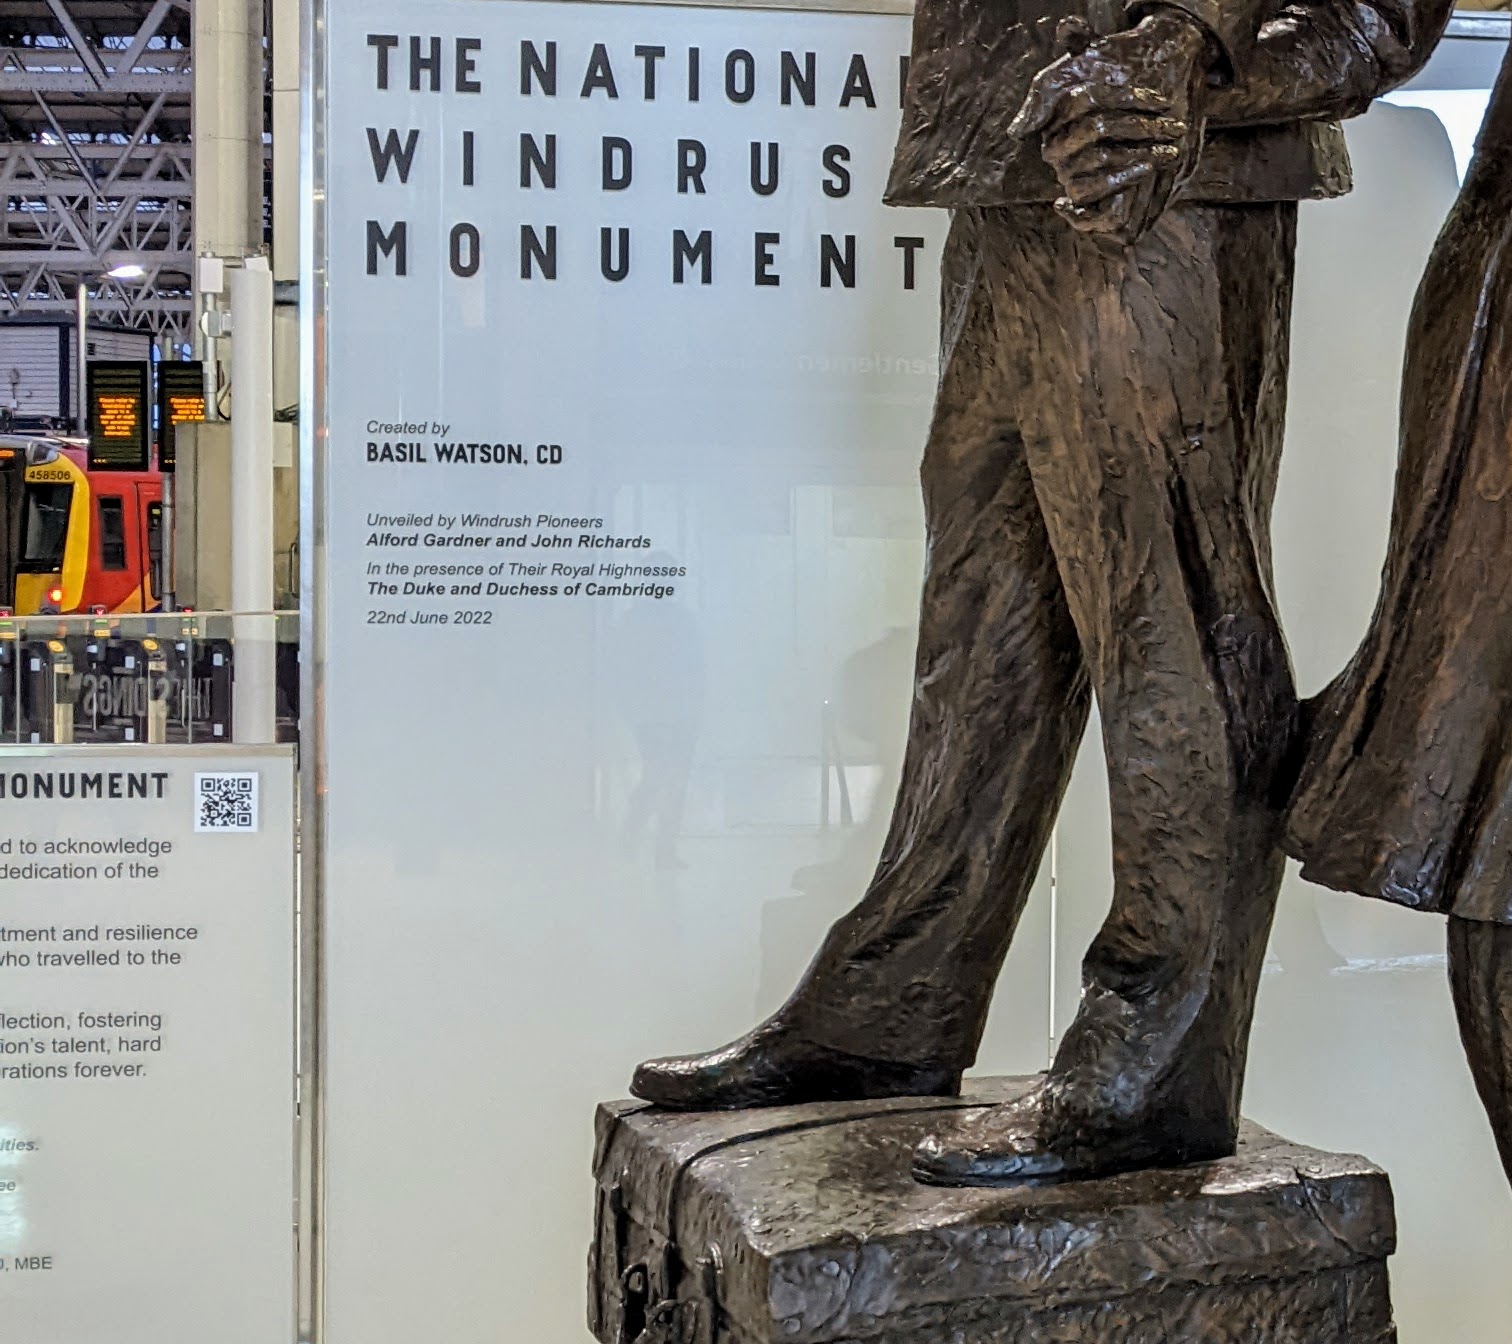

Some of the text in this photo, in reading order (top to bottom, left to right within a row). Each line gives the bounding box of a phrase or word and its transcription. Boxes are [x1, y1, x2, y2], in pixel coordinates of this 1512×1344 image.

[366, 33, 912, 110] THE NATIONA
[366, 128, 897, 198] WINDRUS
[366, 220, 924, 290] MONUMENT
[366, 419, 451, 438] Created by
[366, 441, 562, 466] BASIL WATSON, CD
[29, 470, 71, 480] 458506
[366, 513, 603, 530] Unveiled by Windrush Pioneers
[365, 532, 651, 549] Alford Gardner and John Richards
[366, 561, 687, 580] In the presence of Their Royal Highnesses
[367, 581, 675, 599] The Duke and Duchess of Cambridge
[366, 610, 493, 625] 22nd June 2022
[18, 838, 37, 855] to
[43, 837, 172, 858] acknowledge
[104, 861, 124, 879] of
[128, 861, 159, 879] the
[62, 924, 99, 942] and
[106, 924, 198, 941] resilience
[36, 949, 120, 967] travelled
[126, 949, 145, 965] to
[150, 948, 181, 965] the
[77, 1011, 161, 1031] fostering
[51, 1036, 111, 1055] talent,
[118, 1035, 161, 1052] hard
[73, 1060, 146, 1078] forever.
[14, 1256, 52, 1270] MBE
